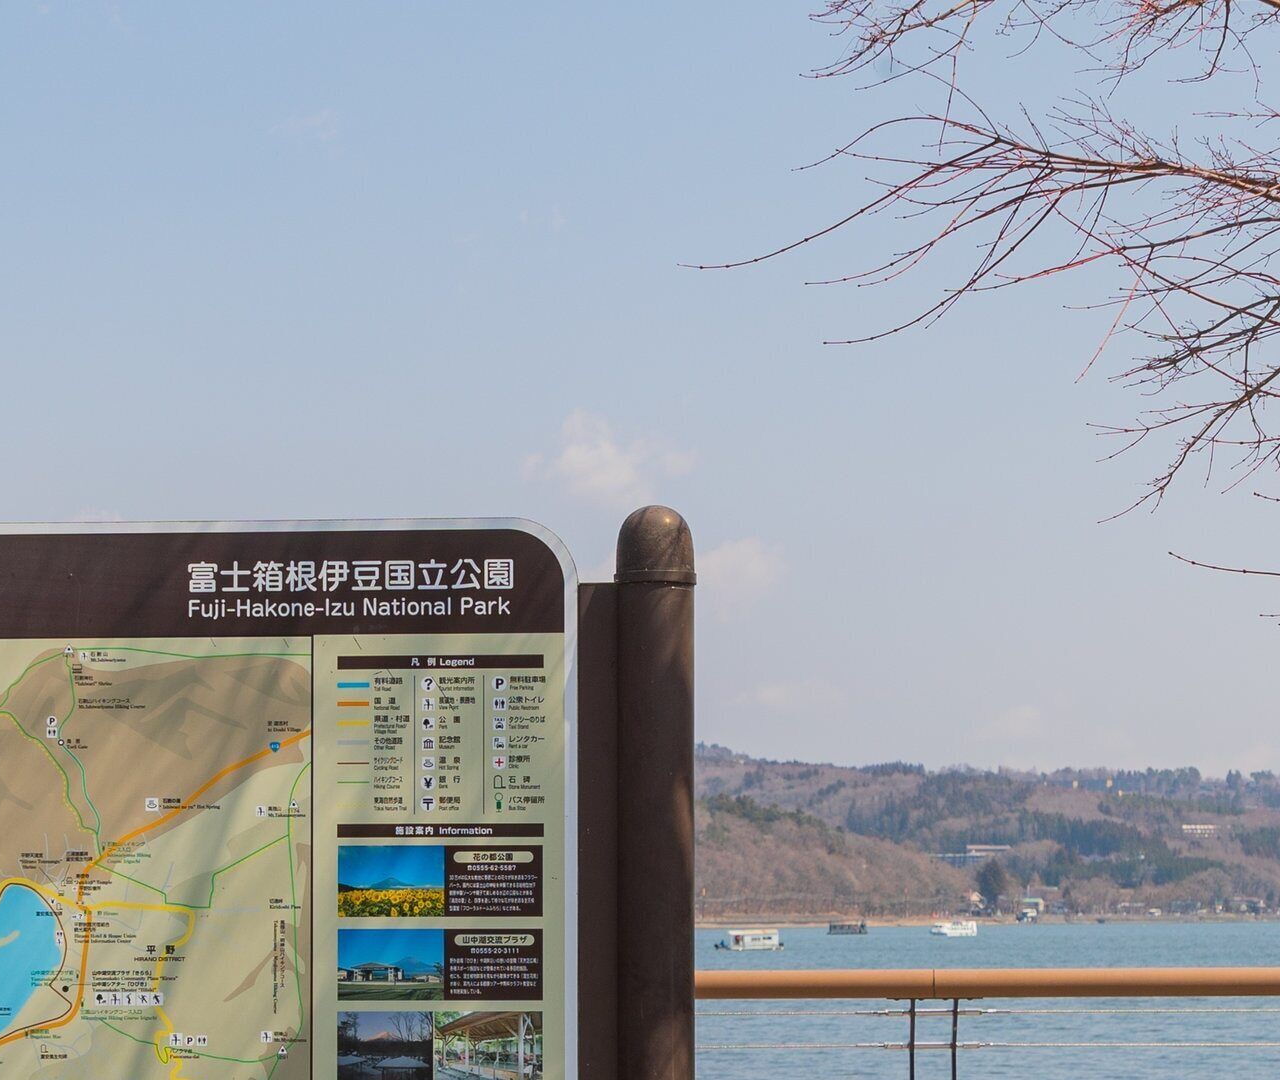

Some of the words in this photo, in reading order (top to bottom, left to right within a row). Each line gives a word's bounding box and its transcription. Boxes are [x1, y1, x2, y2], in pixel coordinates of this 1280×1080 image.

[187, 558, 514, 593] 富士箱根伊豆国立公園
[188, 598, 355, 620] Fuji-Hakone-Izu
[363, 597, 452, 617] National
[460, 597, 511, 615] Park
[440, 658, 475, 667] Legend
[374, 676, 403, 684] 有料道路
[438, 676, 475, 684] 観光案内所
[373, 737, 403, 745] その他道路
[508, 735, 545, 743] レンタカー
[395, 826, 434, 835] 施設案内
[439, 826, 493, 835] Information
[472, 853, 513, 861] 花の都公園
[462, 936, 527, 944] 山中湖交流プラザ
